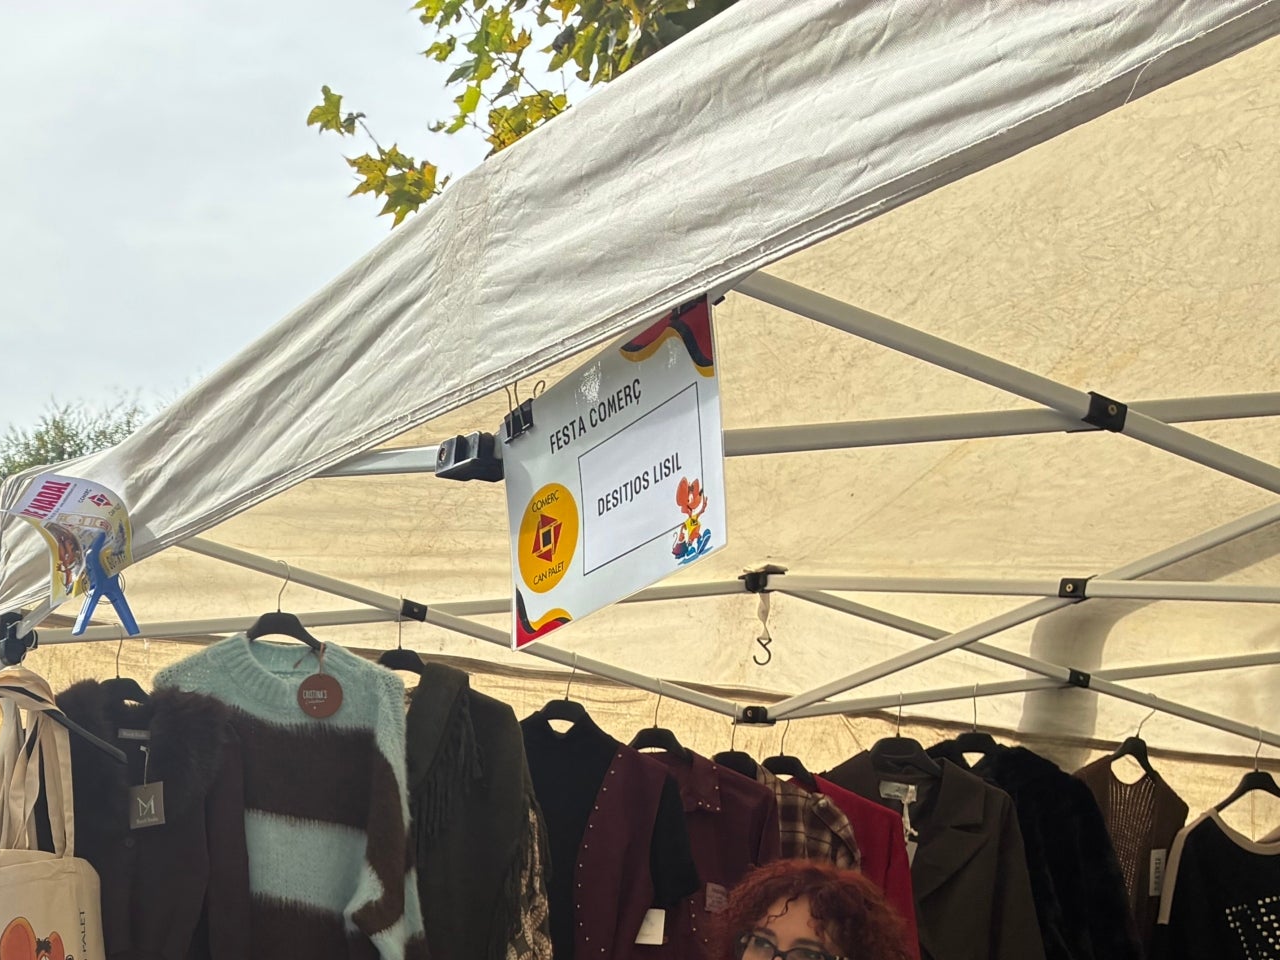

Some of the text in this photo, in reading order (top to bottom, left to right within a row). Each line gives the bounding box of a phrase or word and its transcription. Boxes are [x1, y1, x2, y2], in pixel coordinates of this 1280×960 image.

[549, 378, 642, 455] FESTA COMERÇ
[27, 480, 72, 513] NADAL
[597, 452, 682, 517] DESITJOS LISIL
[533, 560, 565, 586] CAN PALET
[79, 907, 87, 953] PALET
